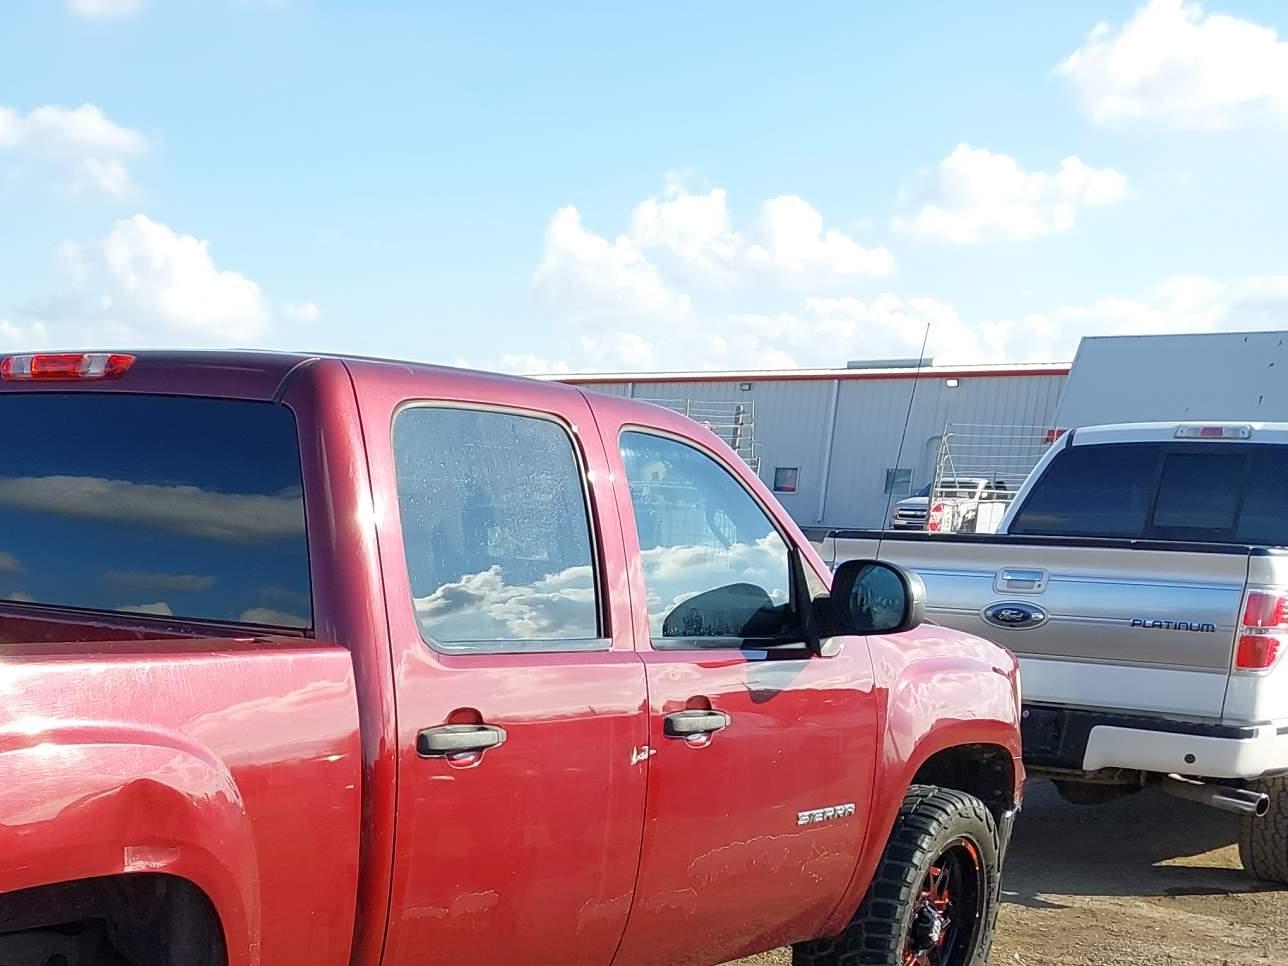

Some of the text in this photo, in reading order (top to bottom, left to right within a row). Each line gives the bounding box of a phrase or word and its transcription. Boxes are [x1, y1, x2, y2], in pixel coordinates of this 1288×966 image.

[999, 609, 1024, 621] Ford
[1130, 618, 1216, 633] PLATINUM
[797, 803, 856, 826] SIERRA
